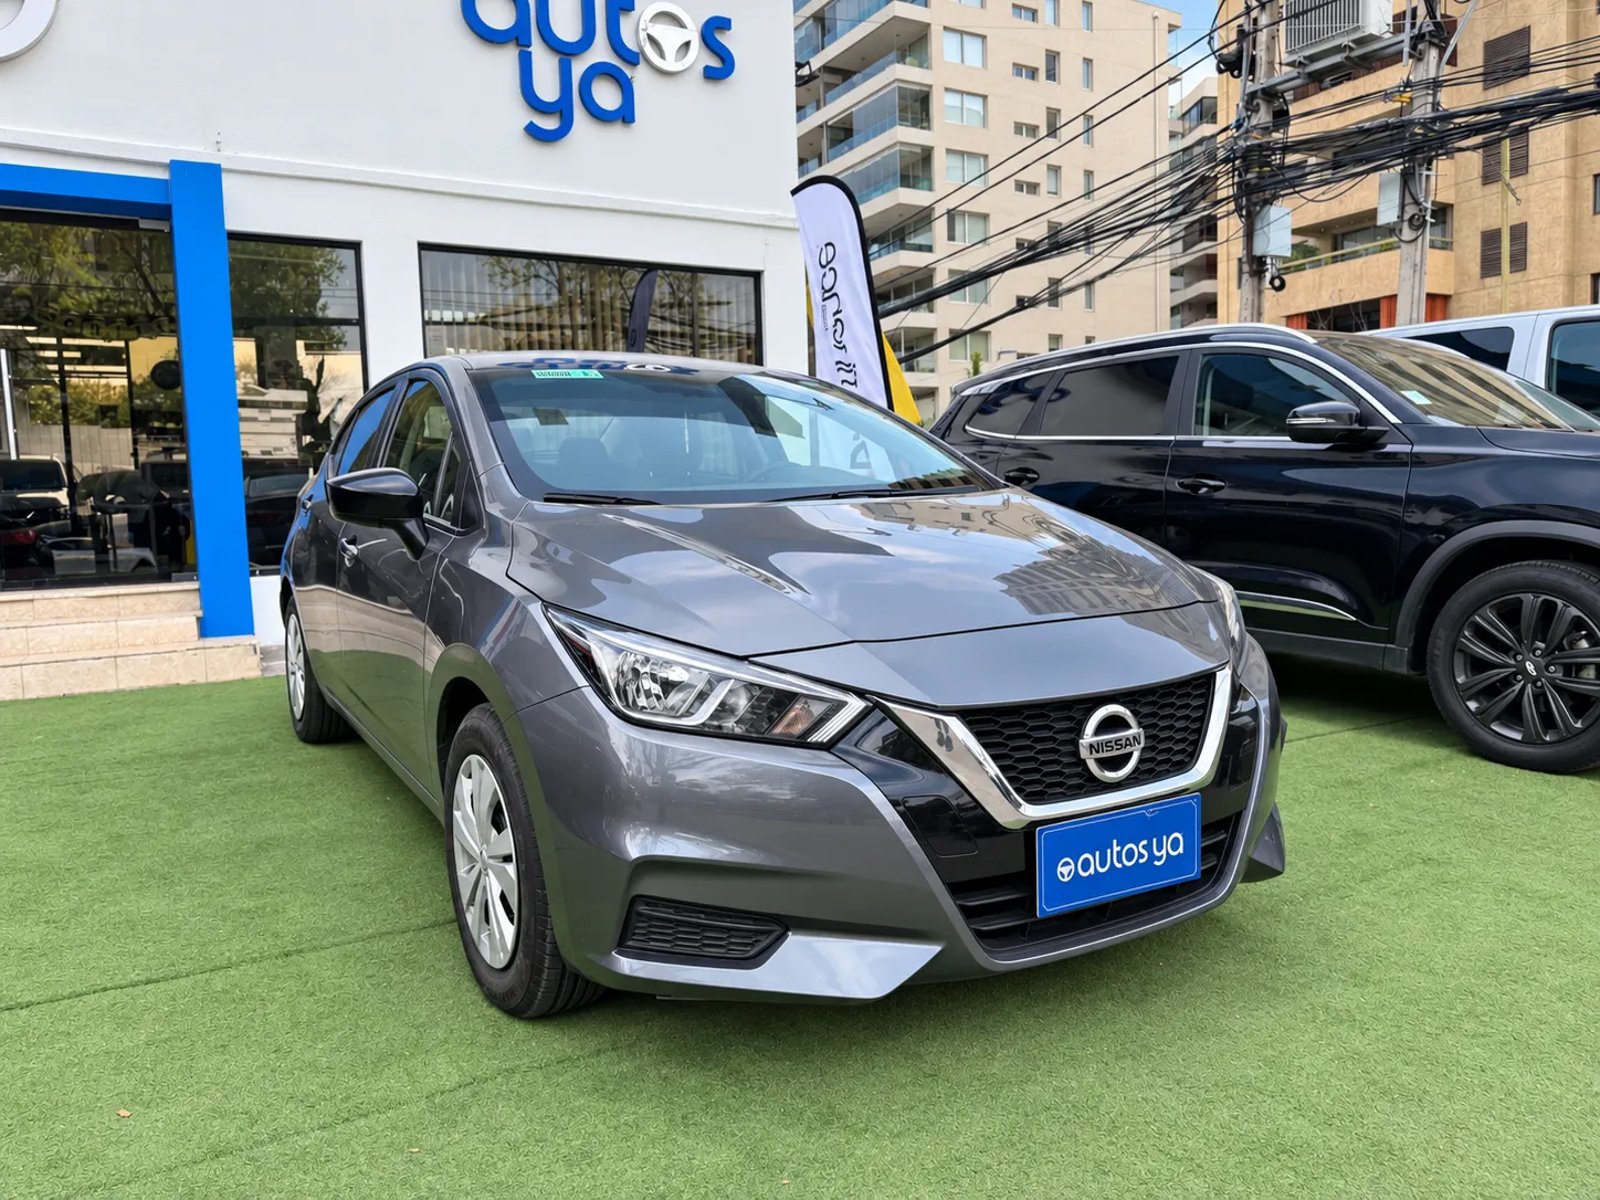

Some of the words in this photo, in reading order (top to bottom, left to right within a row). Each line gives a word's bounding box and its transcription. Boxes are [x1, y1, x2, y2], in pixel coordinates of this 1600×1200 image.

[518, 49, 635, 142] ya
[1089, 734, 1142, 755] NISSAN
[1077, 839, 1149, 877] autos
[1153, 832, 1184, 866] ya
